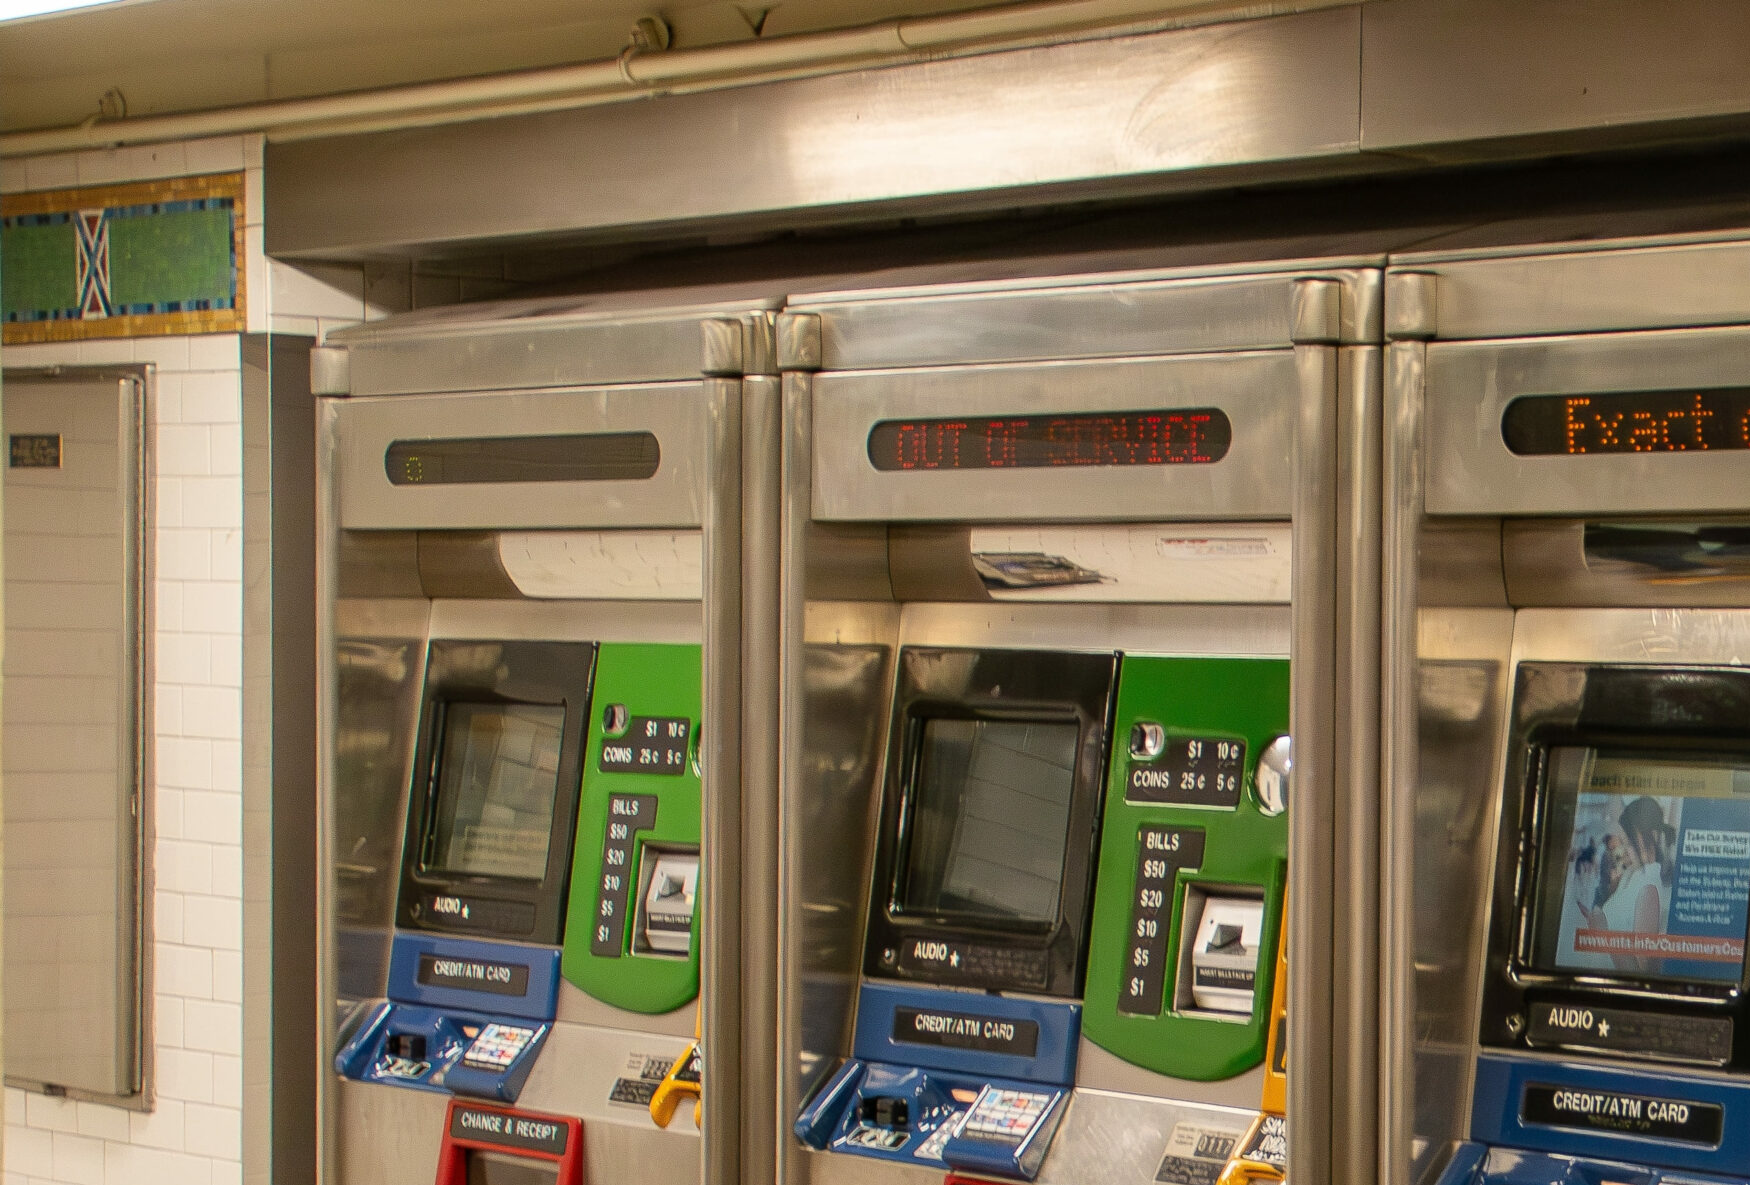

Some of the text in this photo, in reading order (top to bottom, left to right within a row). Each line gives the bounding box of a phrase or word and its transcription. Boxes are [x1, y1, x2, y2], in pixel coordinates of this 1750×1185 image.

[1567, 394, 1714, 454] Exact
[897, 423, 967, 468] OUT
[987, 421, 1029, 467] OF
[645, 720, 657, 737] $1
[603, 746, 632, 763] COINS
[1188, 740, 1202, 759] $1
[1133, 770, 1170, 789] COINS
[612, 799, 639, 816] BILLS
[1147, 832, 1179, 851] BILLS
[607, 848, 624, 866] $20
[1143, 860, 1166, 879] $50
[604, 874, 621, 892] $10
[434, 896, 460, 914] AUDIO
[1140, 888, 1162, 908] $20
[598, 925, 610, 942] $1
[1136, 918, 1157, 938] $10
[914, 941, 947, 961] AUDIO
[1133, 947, 1149, 967] $5
[434, 960, 511, 983] CREDIT/ATM CARD
[1130, 976, 1144, 997] $1
[915, 1014, 1014, 1041] CREDIT/ATM CARD
[1549, 1007, 1594, 1030] AUDIO
[1553, 1090, 1689, 1124] CREDIT/ATM CARD
[461, 1112, 558, 1141] CHANGE & RECEIPT
